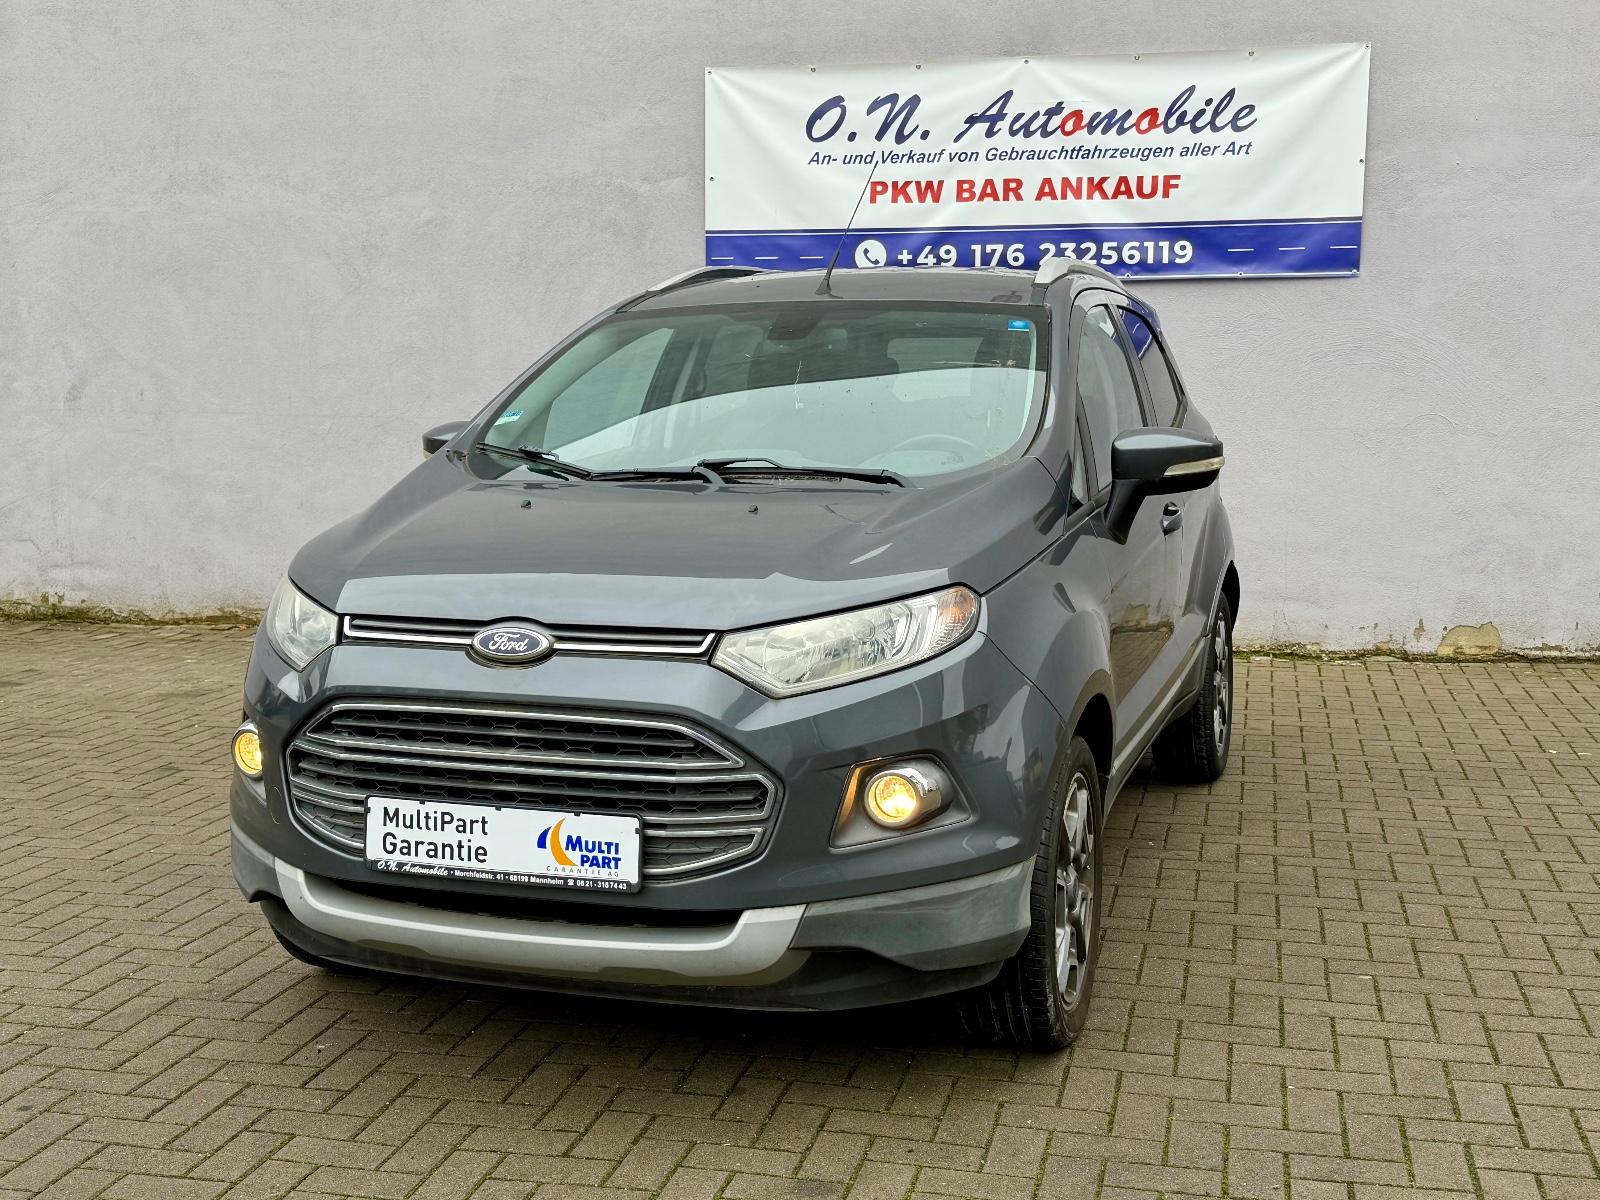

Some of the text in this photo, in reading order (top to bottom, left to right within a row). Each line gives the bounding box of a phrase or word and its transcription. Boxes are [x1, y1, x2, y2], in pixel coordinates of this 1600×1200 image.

[952, 84, 1258, 143] Automobile
[807, 140, 1254, 165] An- und Verkauf von Gebrauchtfahrzeugen aller Art
[869, 174, 1182, 204] PKW BAR ANKAUF
[896, 239, 1194, 268] +49 176 23256119
[488, 632, 530, 651] Ford
[382, 806, 489, 836] MultiPart
[382, 831, 488, 864] Garantie
[580, 854, 622, 870] PART
[400, 862, 449, 876] Automobile
[529, 875, 564, 885] Mannheim
